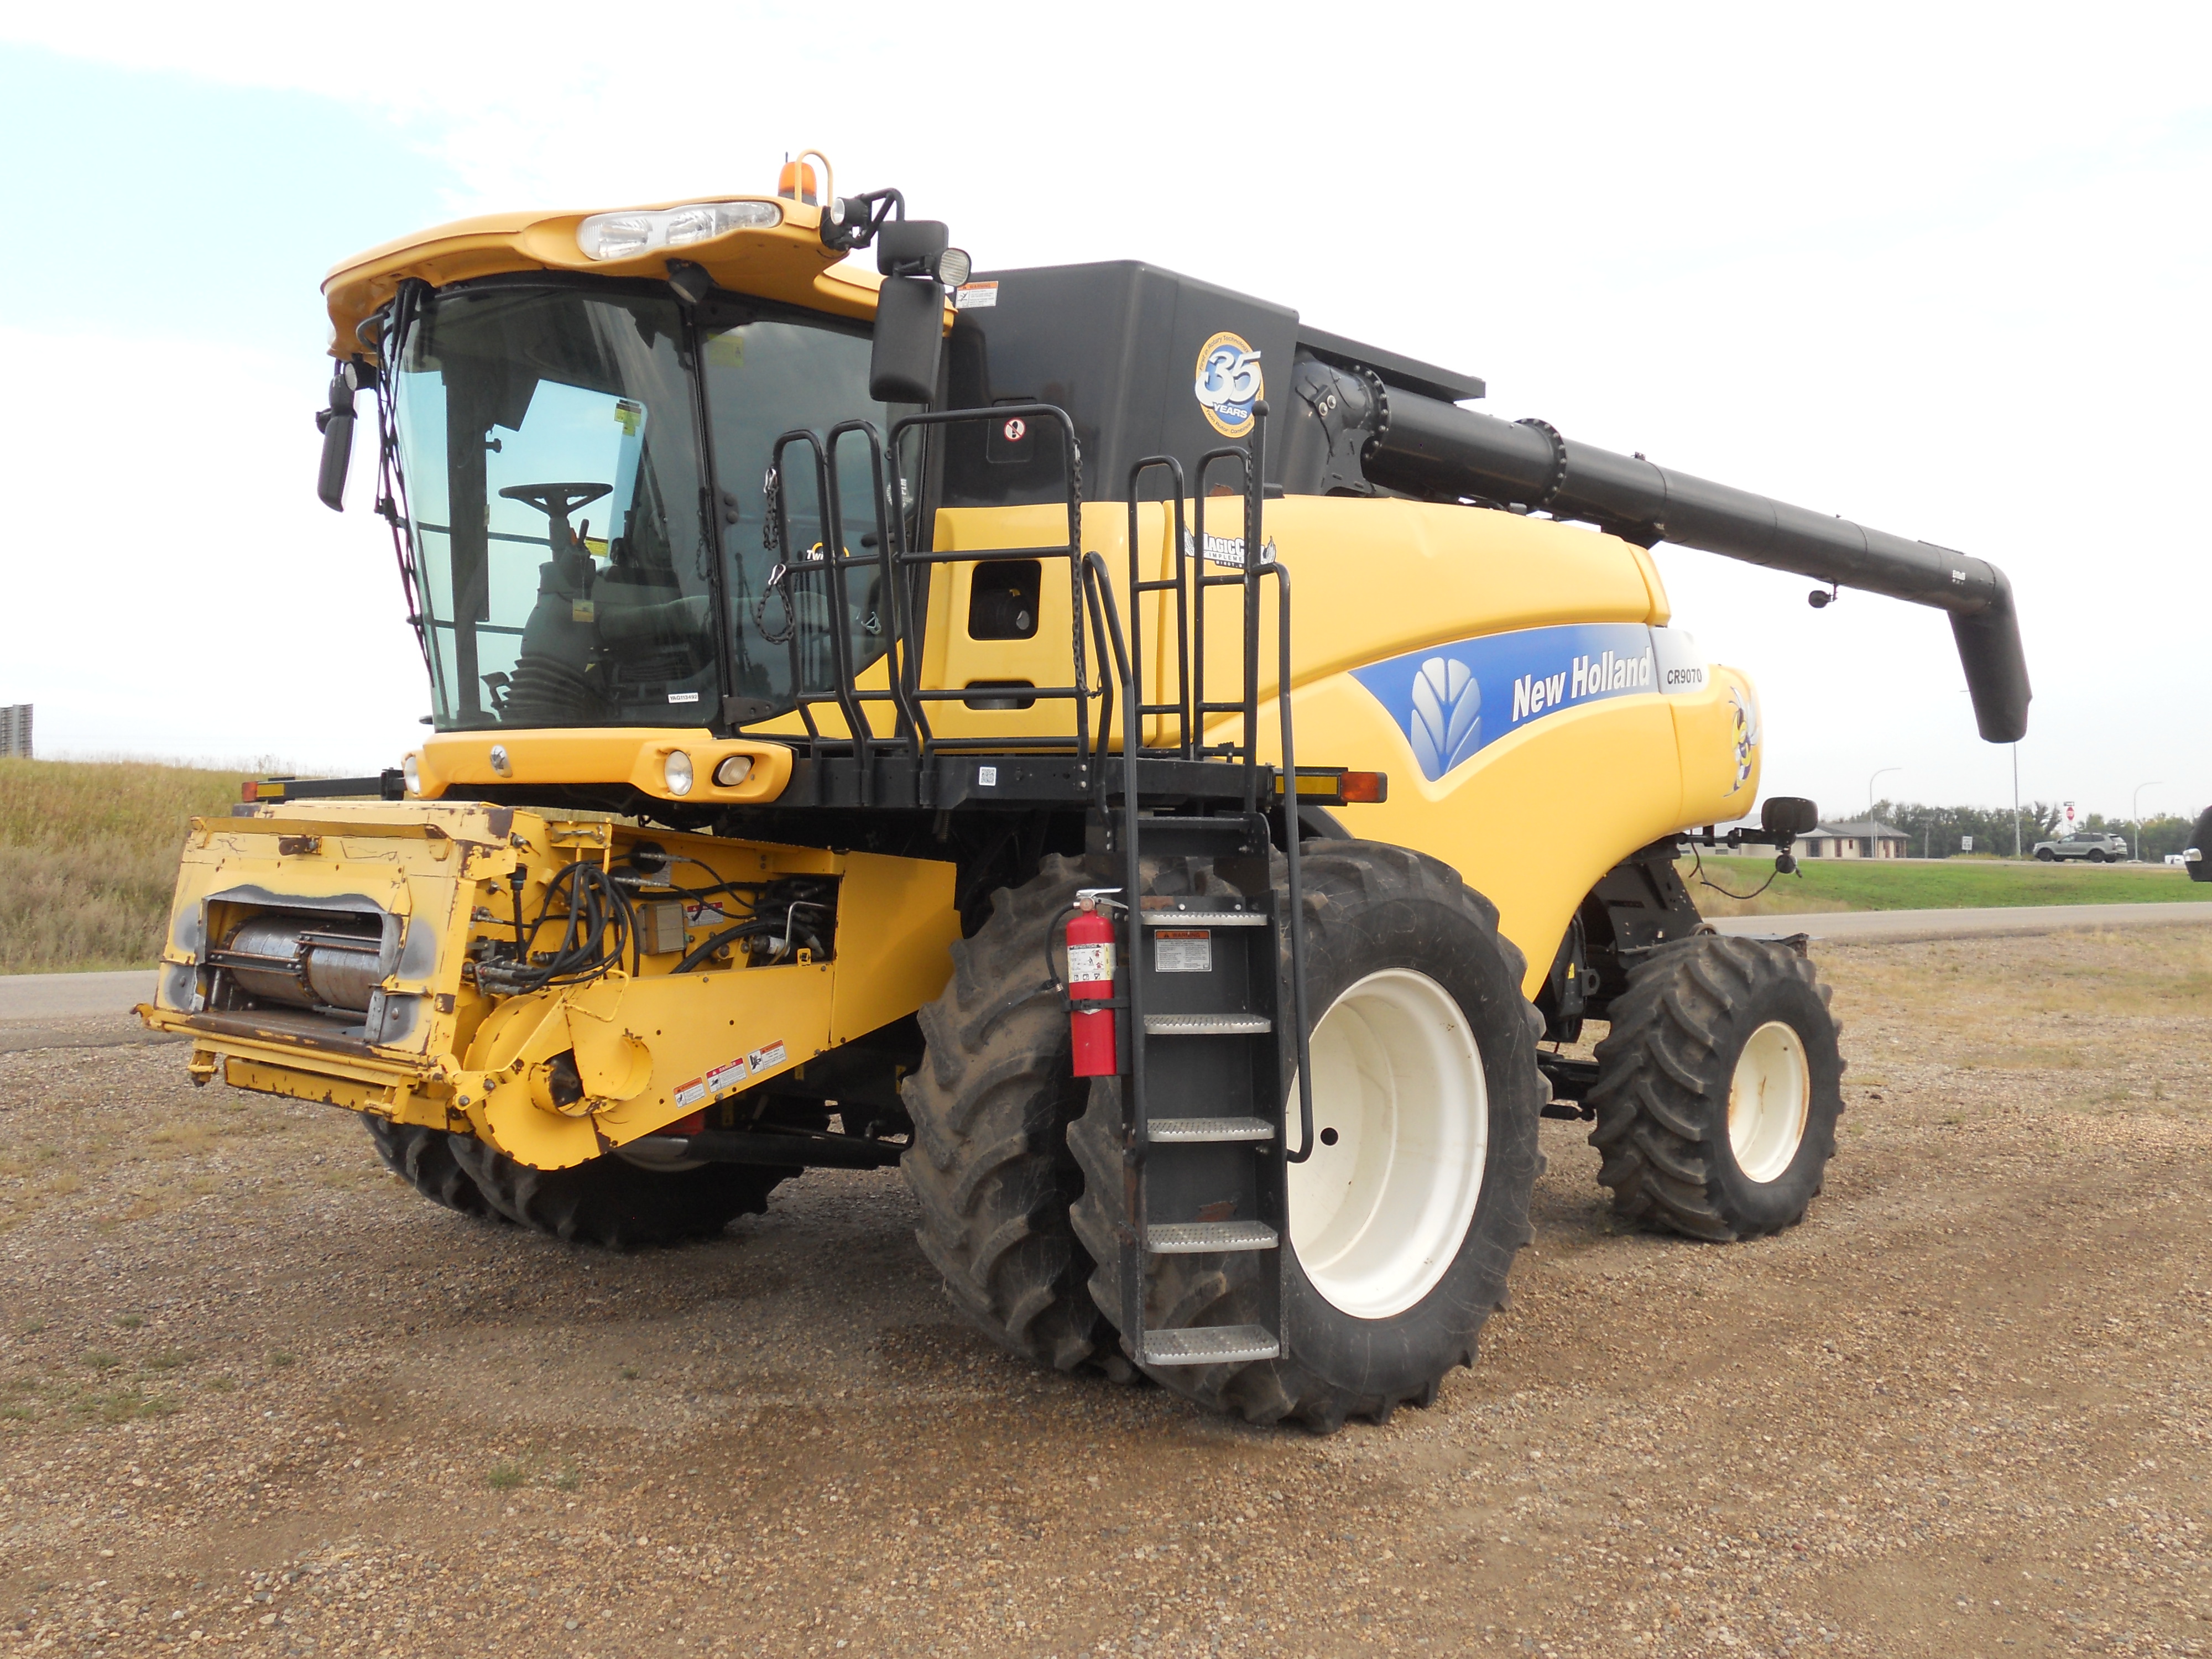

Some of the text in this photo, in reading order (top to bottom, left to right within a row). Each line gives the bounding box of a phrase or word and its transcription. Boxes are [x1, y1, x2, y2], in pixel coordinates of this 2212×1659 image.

[1208, 337, 1222, 349] Rotary
[1223, 335, 1249, 353] Technology
[1195, 351, 1261, 406] 35
[1213, 402, 1248, 419] YEARS
[1206, 409, 1215, 422] Twin
[1215, 421, 1228, 432] Rotor
[807, 550, 824, 560] Twi
[1209, 552, 1243, 562] IMPLEME
[1512, 646, 1651, 722] New Holland
[1667, 667, 1703, 685] CR9070
